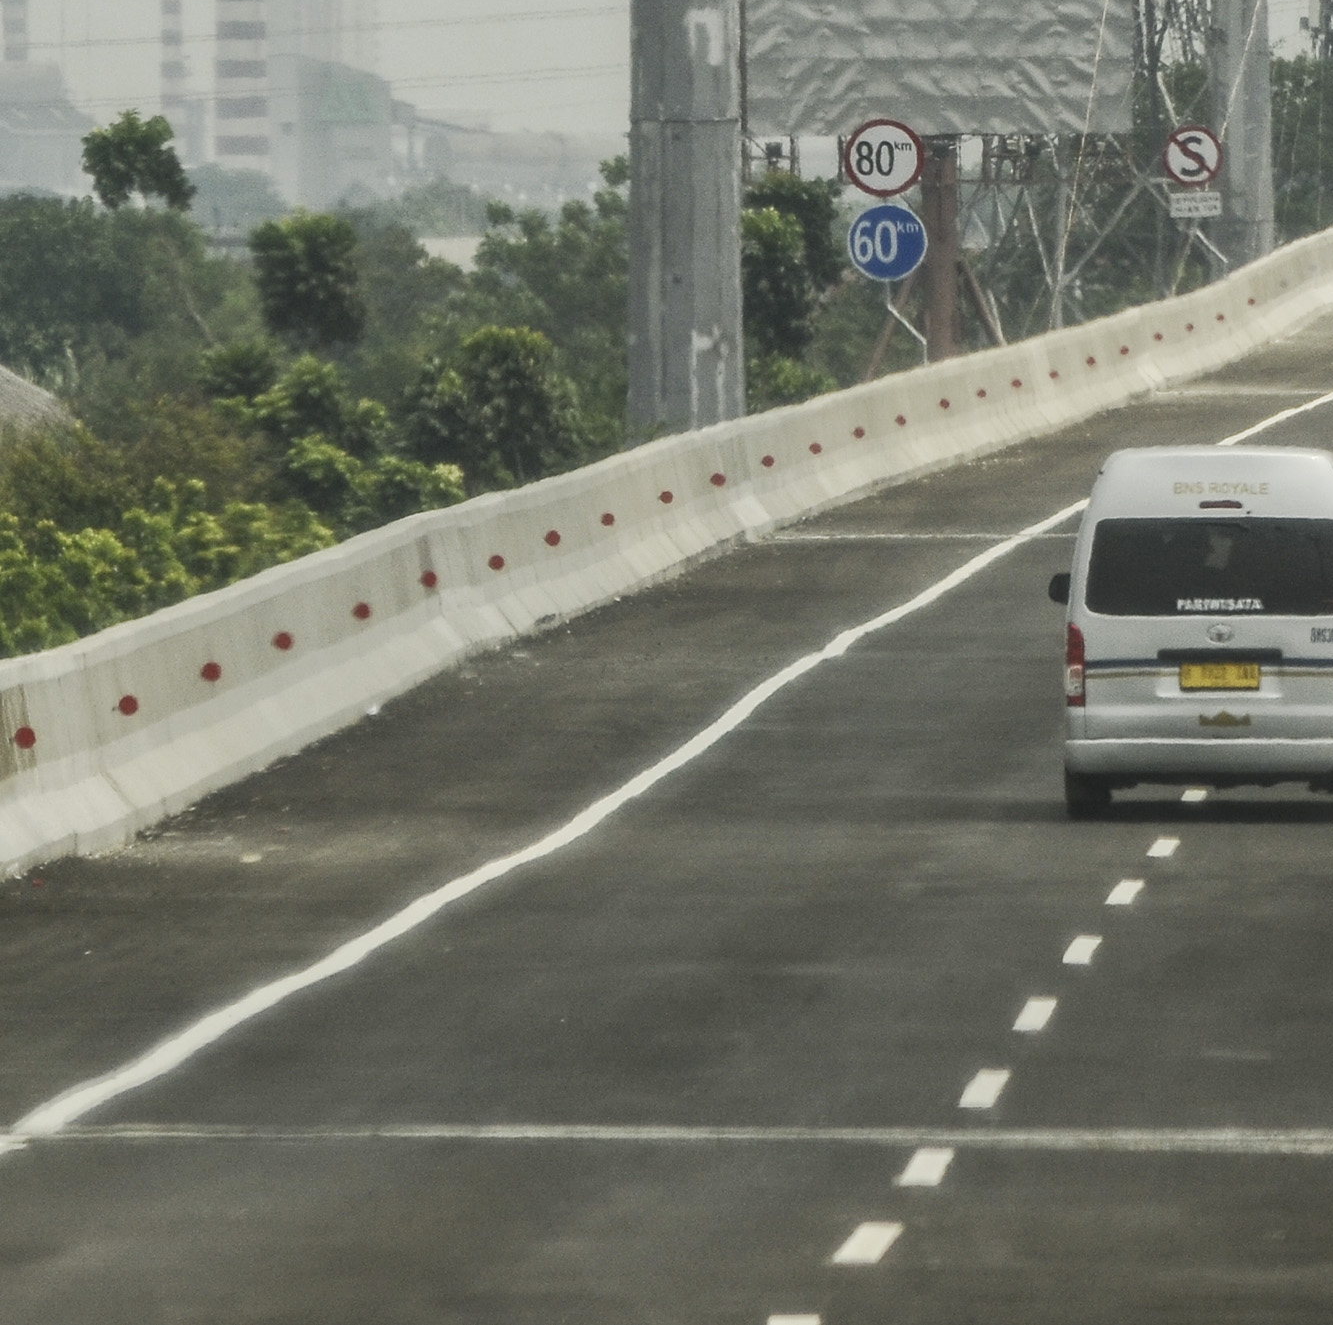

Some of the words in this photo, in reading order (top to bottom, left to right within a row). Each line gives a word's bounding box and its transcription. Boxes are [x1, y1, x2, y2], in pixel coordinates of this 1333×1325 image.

[856, 140, 895, 176] 80
[894, 140, 912, 151] km
[854, 220, 898, 264] 60
[1208, 481, 1269, 495] ROYALE
